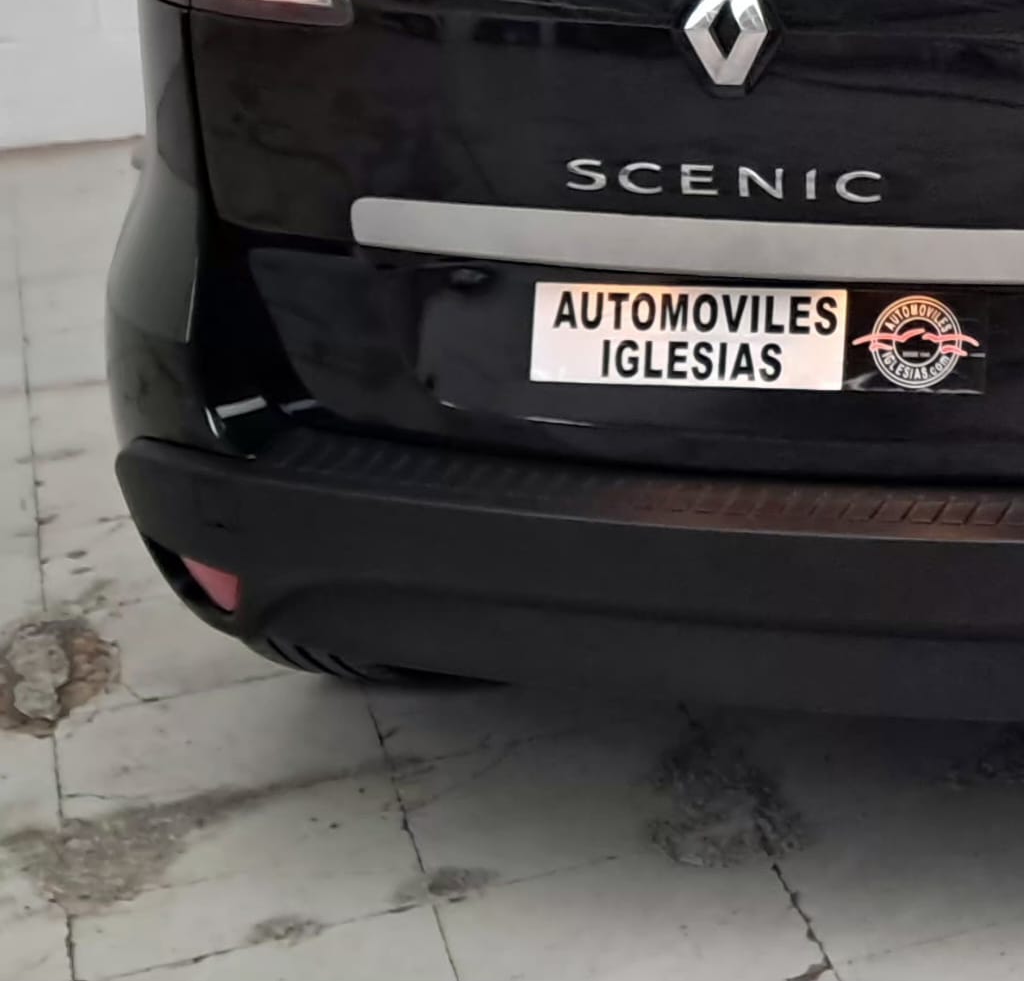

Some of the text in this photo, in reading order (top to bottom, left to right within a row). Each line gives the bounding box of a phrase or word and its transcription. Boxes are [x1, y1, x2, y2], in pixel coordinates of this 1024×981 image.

[565, 158, 883, 204] SCENIC
[552, 290, 838, 336] AUTOMOVILES
[884, 303, 953, 333] AUTOMOVILES
[601, 338, 783, 382] IGLESIAS
